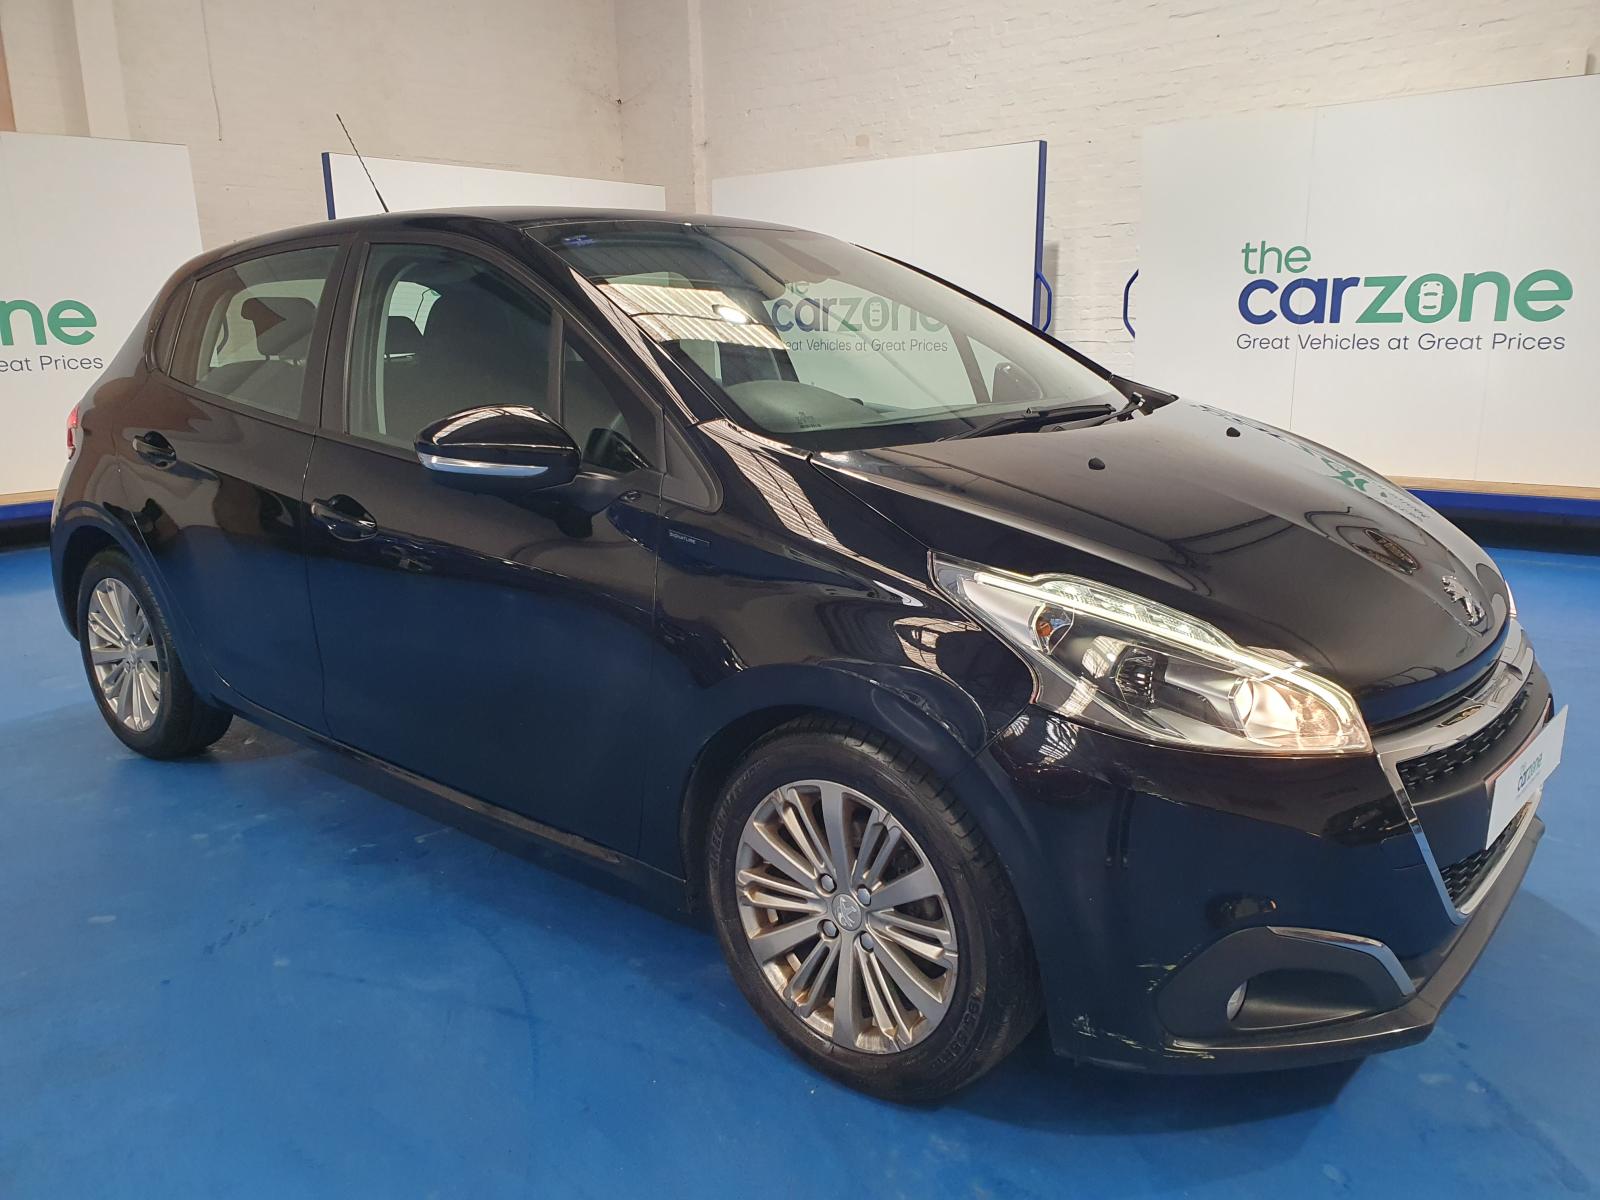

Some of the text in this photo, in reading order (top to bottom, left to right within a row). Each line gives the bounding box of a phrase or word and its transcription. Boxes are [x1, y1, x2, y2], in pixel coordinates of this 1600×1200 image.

[1241, 240, 1312, 275] the
[1238, 269, 1574, 325] carzone
[806, 338, 851, 351] Vehicles
[855, 339, 867, 351] at
[871, 338, 906, 352] Great
[910, 338, 948, 352] Prices
[1236, 332, 1566, 350] Great Vehicles at Great Prices
[39, 355, 104, 371] Prices
